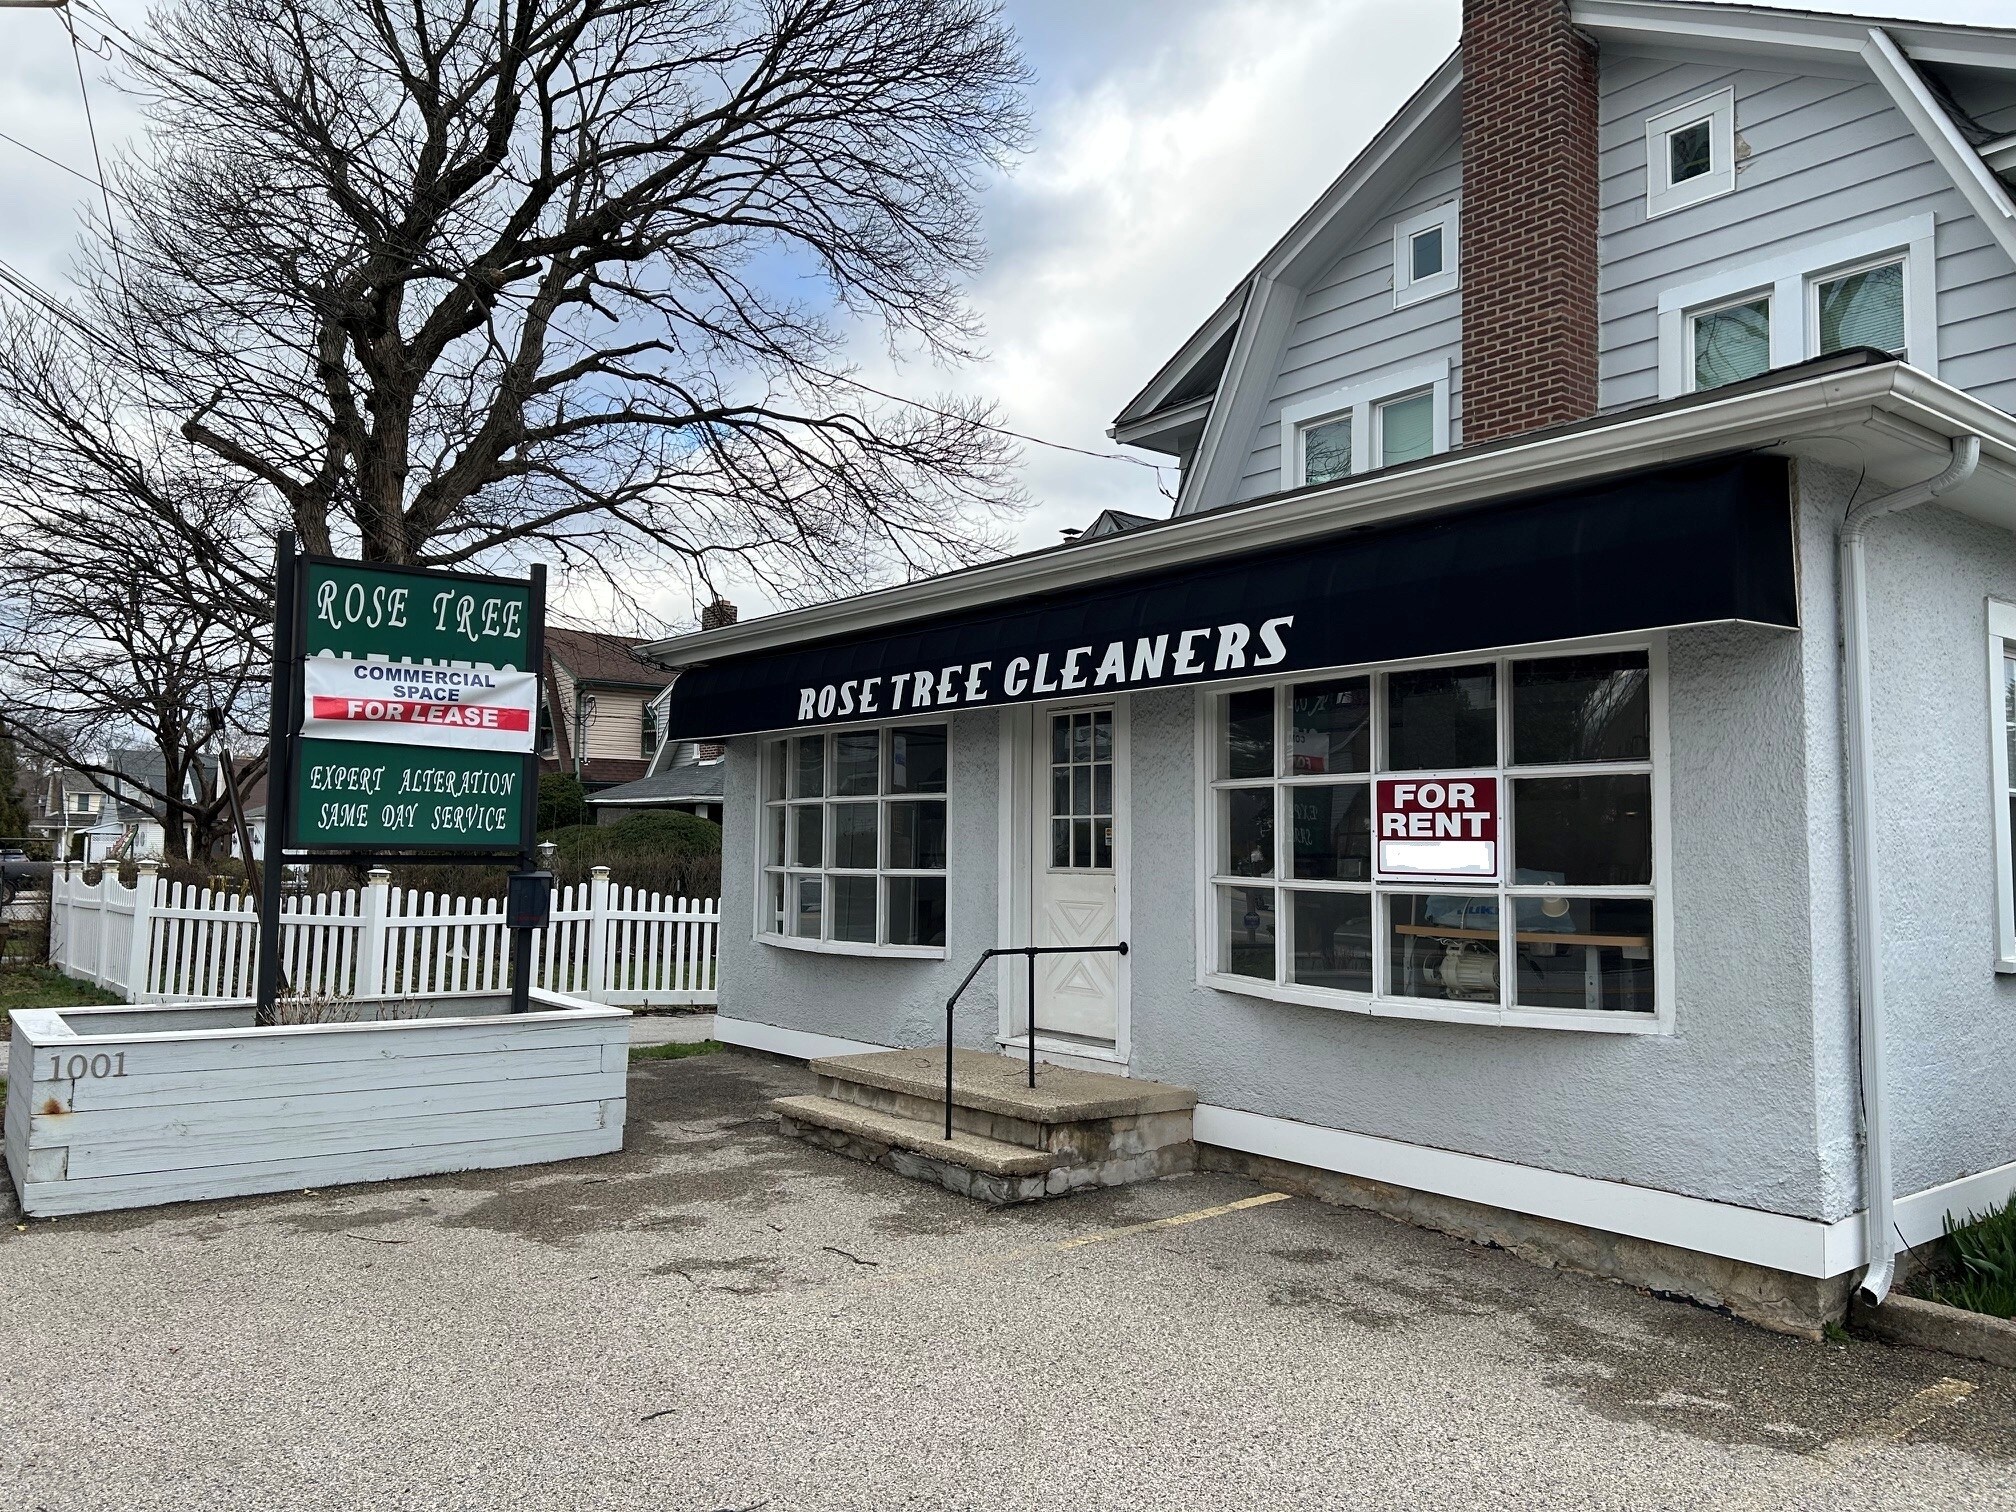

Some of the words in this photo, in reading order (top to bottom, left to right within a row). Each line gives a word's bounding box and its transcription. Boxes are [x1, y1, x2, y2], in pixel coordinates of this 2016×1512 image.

[317, 580, 409, 630] ROSE
[432, 589, 523, 642] TREE
[353, 665, 496, 688] COMMERCIAL
[797, 677, 882, 720] ROSE
[890, 661, 992, 708] TREE
[1003, 615, 1294, 696] CLEANERS
[392, 684, 461, 703] SPACE
[347, 700, 404, 720] FOR
[410, 703, 499, 728] LEASE
[310, 764, 386, 796] EXPERT
[398, 767, 516, 798] ALTERATION
[1394, 782, 1475, 809] FOR
[317, 802, 369, 831] SAME
[381, 802, 418, 831] DAY
[431, 803, 507, 834] SERVICE
[1382, 812, 1491, 837] RENT
[50, 1051, 128, 1081] 1001
